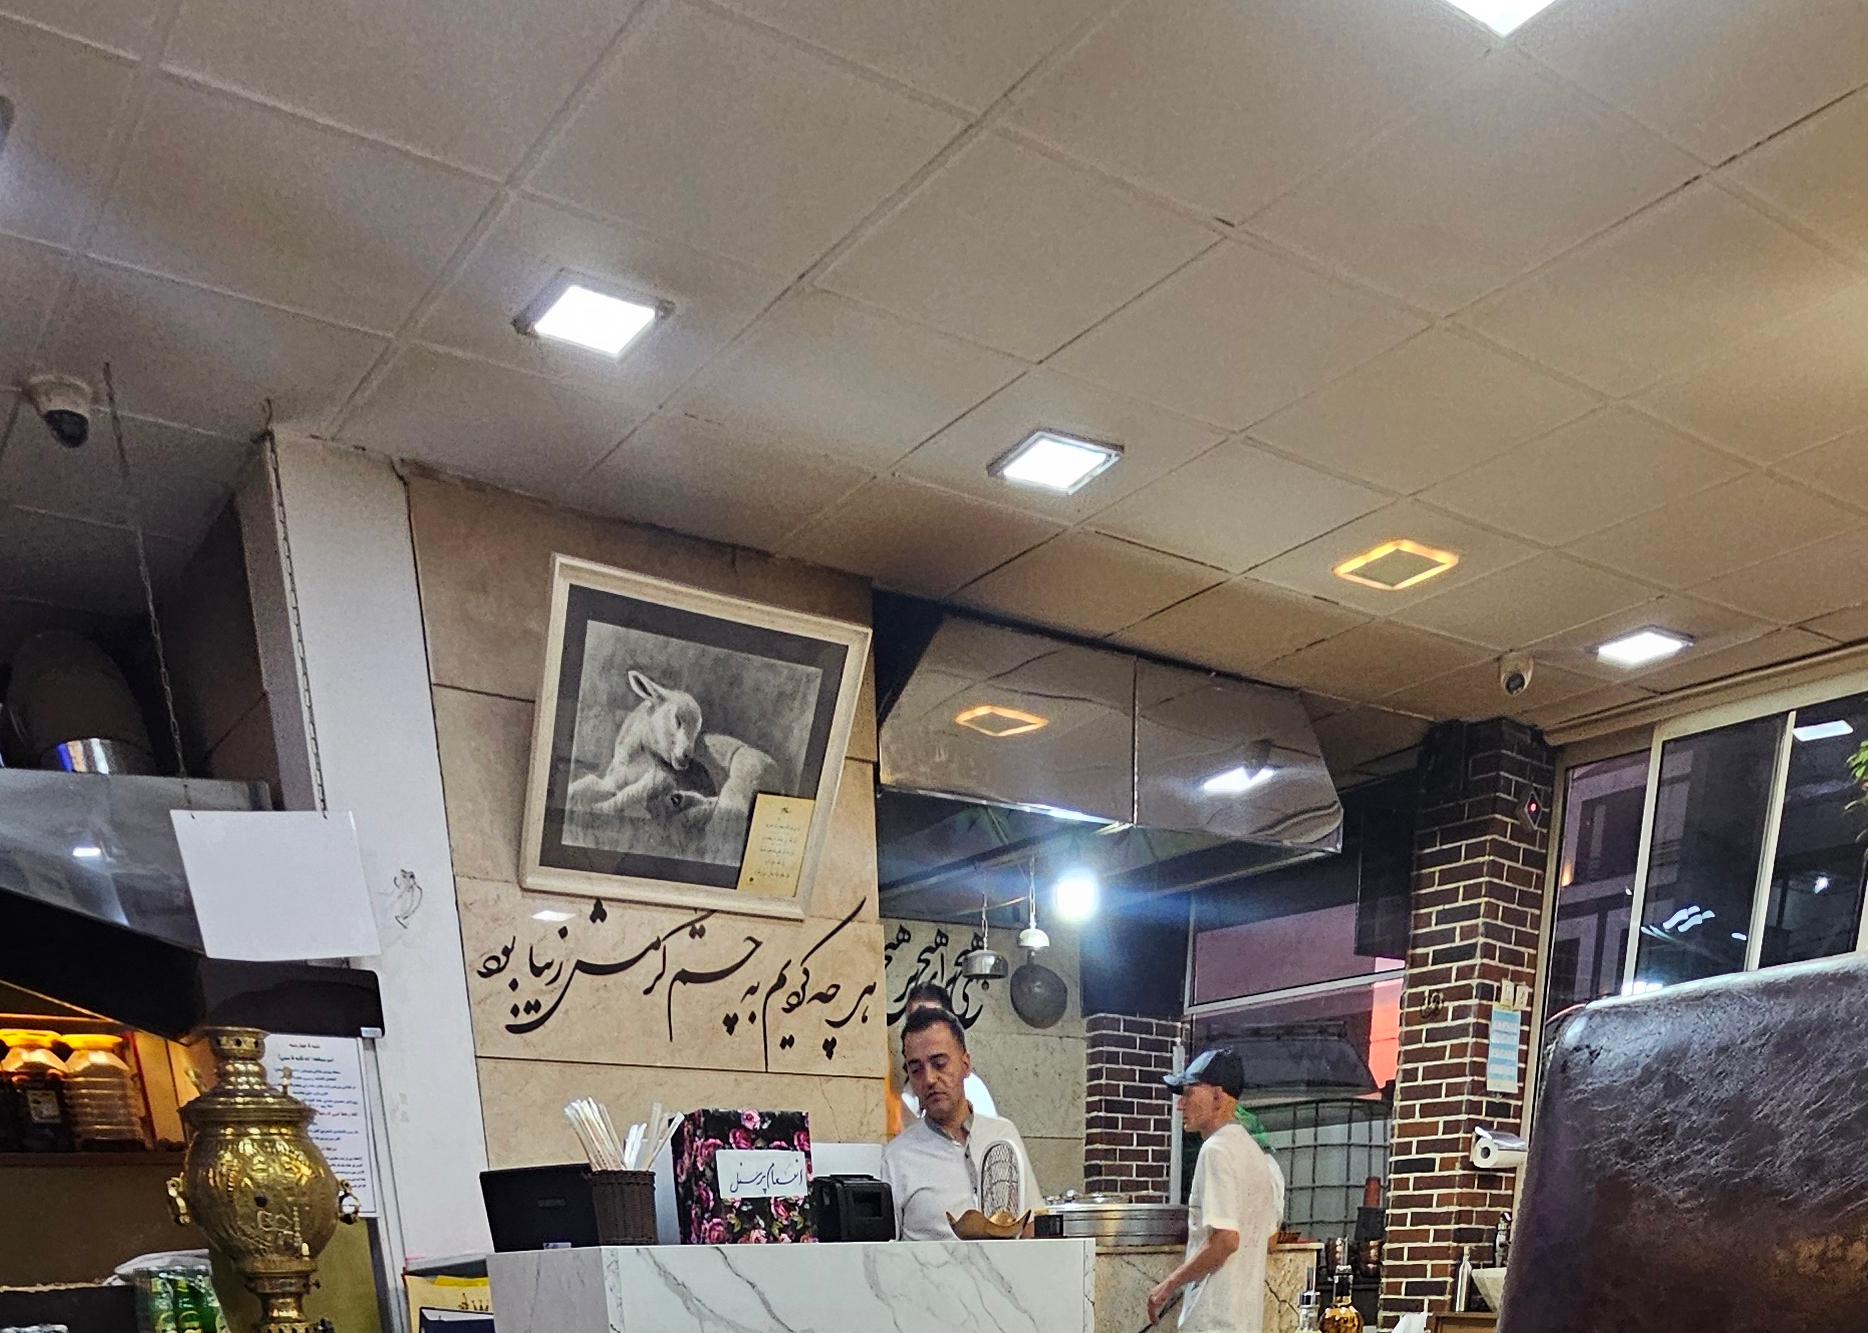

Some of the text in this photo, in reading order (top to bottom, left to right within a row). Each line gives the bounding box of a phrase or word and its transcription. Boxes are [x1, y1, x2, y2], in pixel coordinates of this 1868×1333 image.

[477, 936, 519, 992] بود
[668, 911, 763, 1042] چشم
[740, 981, 761, 1024] به
[824, 981, 877, 1029] هر
[730, 1158, 803, 1195] انعام پرسنل
